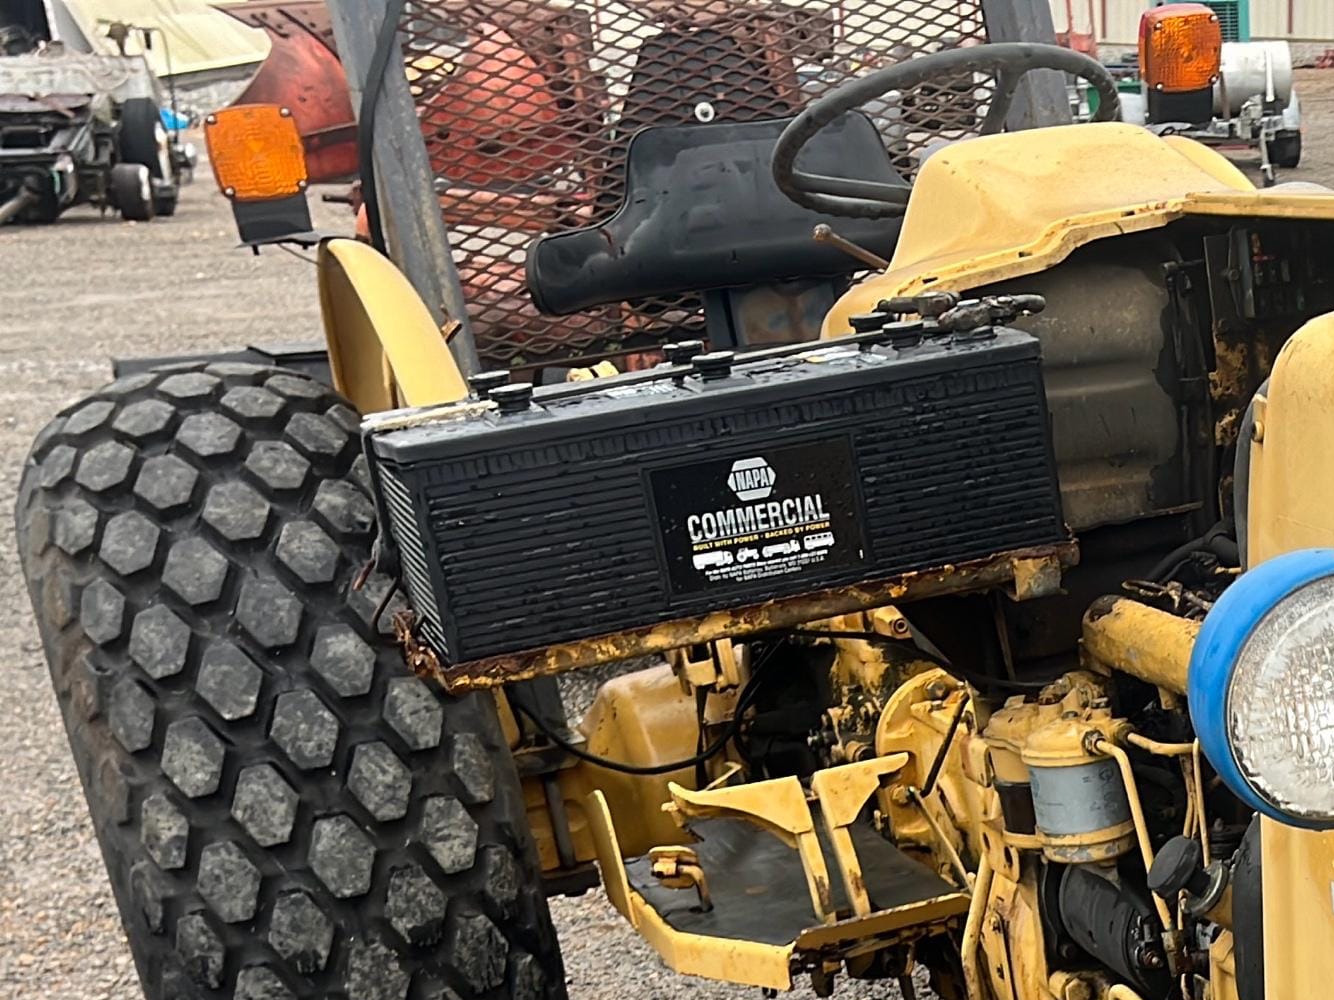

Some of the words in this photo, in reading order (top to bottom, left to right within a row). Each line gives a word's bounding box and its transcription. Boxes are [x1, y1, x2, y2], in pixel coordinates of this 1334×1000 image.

[735, 467, 770, 491] NAPA
[687, 494, 831, 541] COMMERCIAL
[692, 542, 713, 551] BUILT
[714, 539, 733, 548] WITH
[733, 534, 759, 545] POWER
[764, 528, 794, 539] BACKED
[794, 526, 804, 534] BY
[805, 521, 830, 531] POWER
